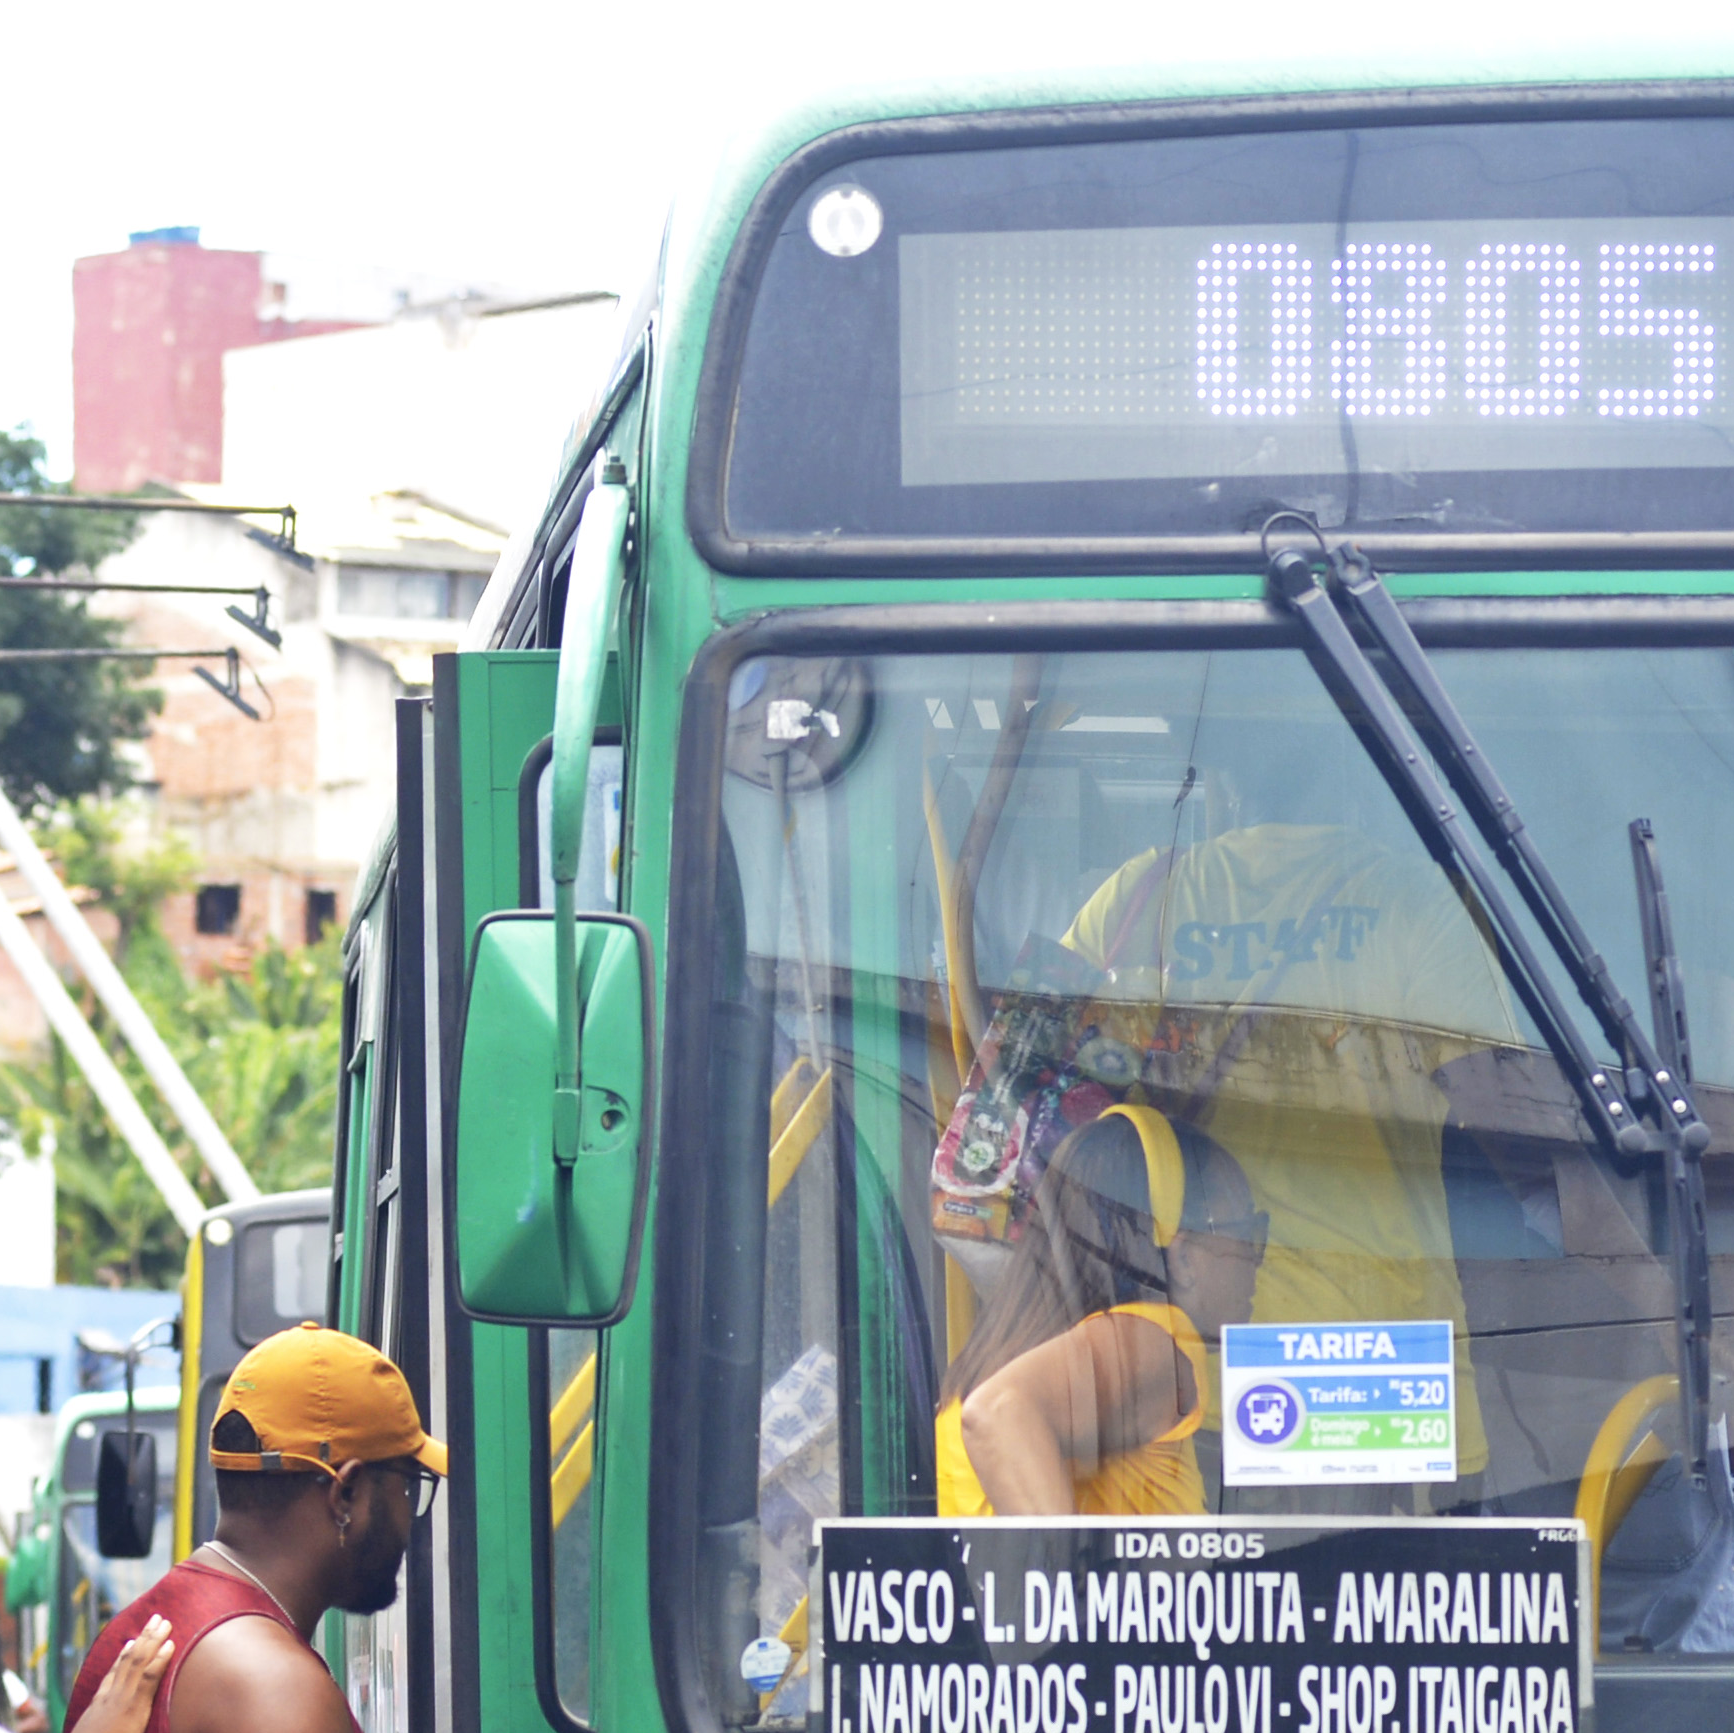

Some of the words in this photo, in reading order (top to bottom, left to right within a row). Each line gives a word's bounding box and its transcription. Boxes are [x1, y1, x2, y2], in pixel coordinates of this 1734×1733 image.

[1194, 241, 1716, 419] 0805
[1170, 905, 1380, 983] STAFF
[1278, 1331, 1396, 1360] TARIFA
[1308, 1387, 1367, 1404] Tarifa:
[1400, 1380, 1445, 1408] 5,20
[1310, 1417, 1370, 1434] Domingo
[1401, 1418, 1447, 1447] 2,60
[1114, 1533, 1172, 1559] IDA
[1177, 1532, 1265, 1559] 0805
[830, 1571, 954, 1644] VASCO
[984, 1571, 1015, 1644] L.
[1024, 1571, 1078, 1644] DA
[1087, 1570, 1305, 1660] MARIQUITA
[1334, 1572, 1566, 1644] AMARALINA
